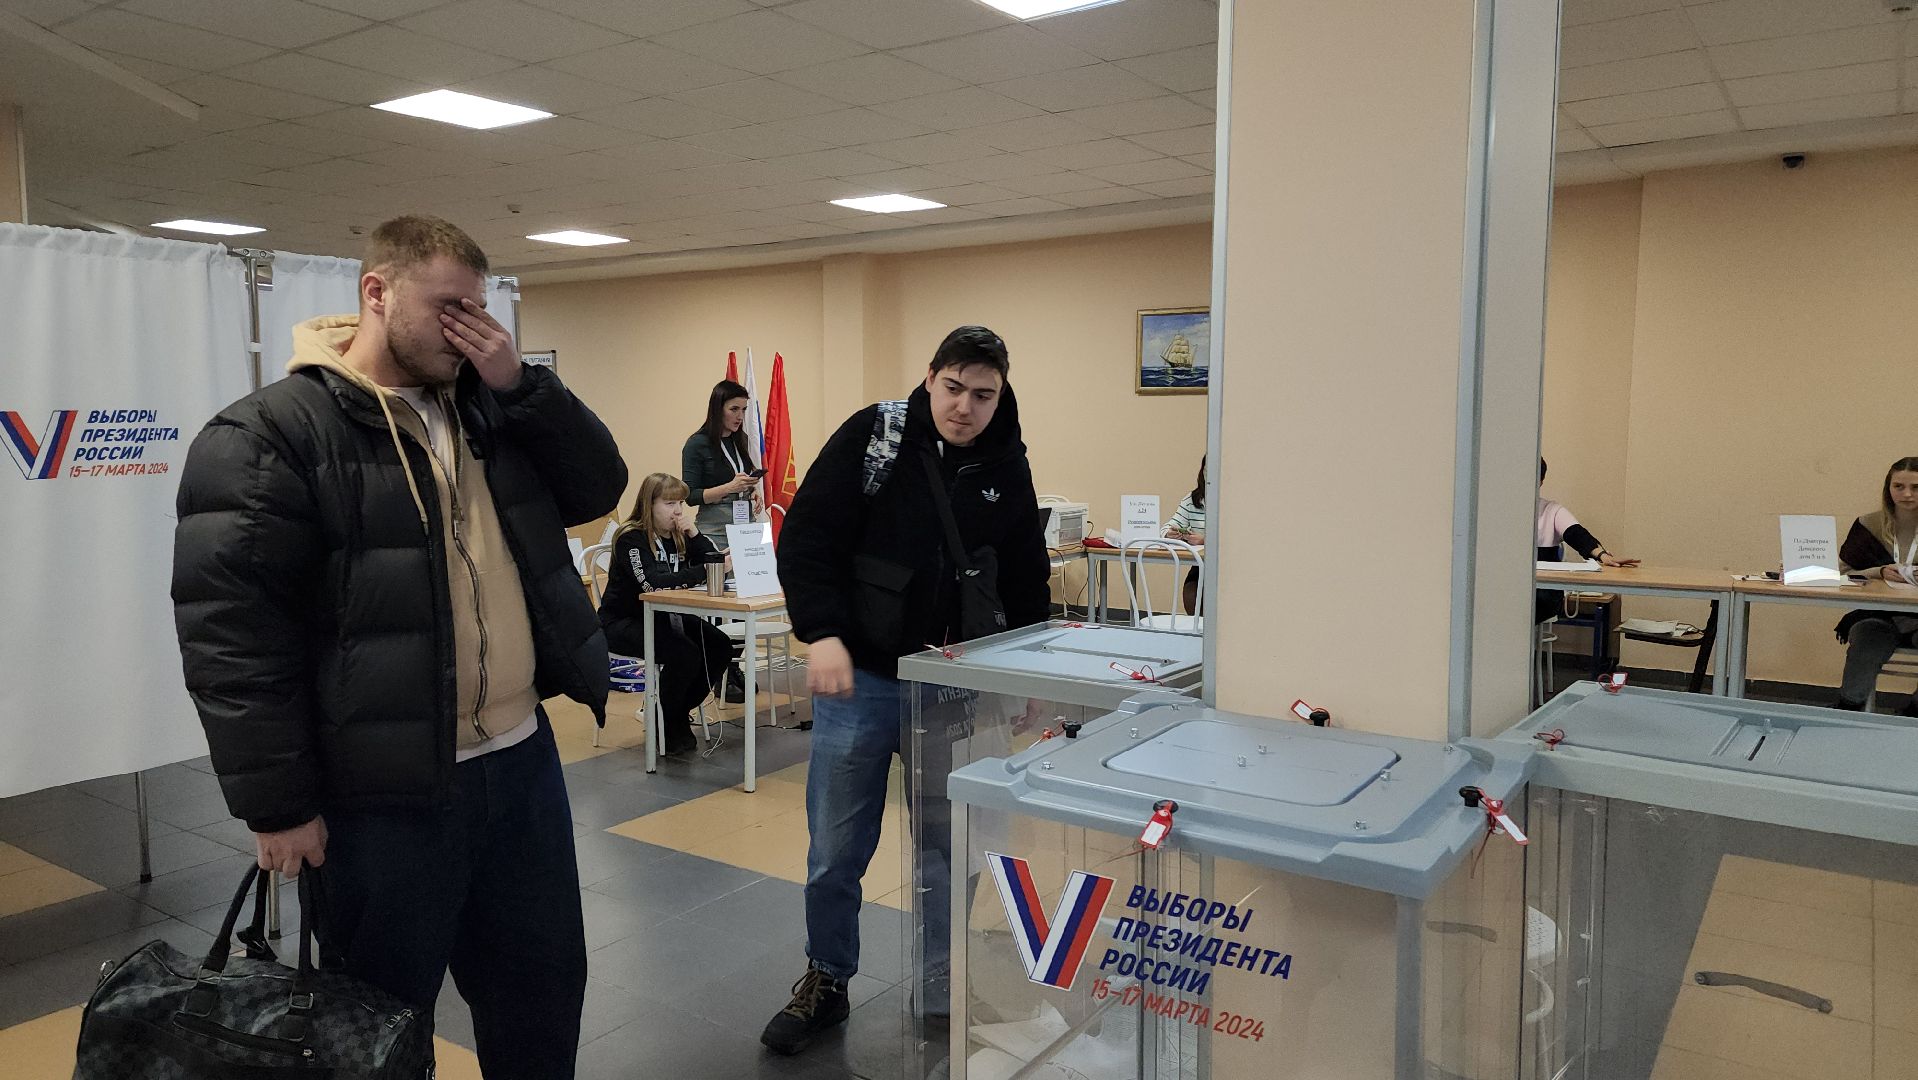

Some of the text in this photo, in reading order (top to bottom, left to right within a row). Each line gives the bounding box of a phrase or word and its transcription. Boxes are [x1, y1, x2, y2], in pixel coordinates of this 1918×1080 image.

[87, 409, 157, 424] ВЫБОРЫ
[80, 427, 179, 443] ПРЕЗИДЕНТА
[73, 446, 144, 461] РОССИИ
[105, 464, 146, 477] МАРТА
[148, 462, 169, 475] 2024
[1126, 884, 1254, 933] ВЫБОРЫ
[1112, 916, 1293, 980] ПРЕЗИДЕНТА
[1099, 948, 1211, 996] РОССИИ
[1143, 992, 1211, 1028] МАРТА
[1214, 1011, 1265, 1042] 2024
